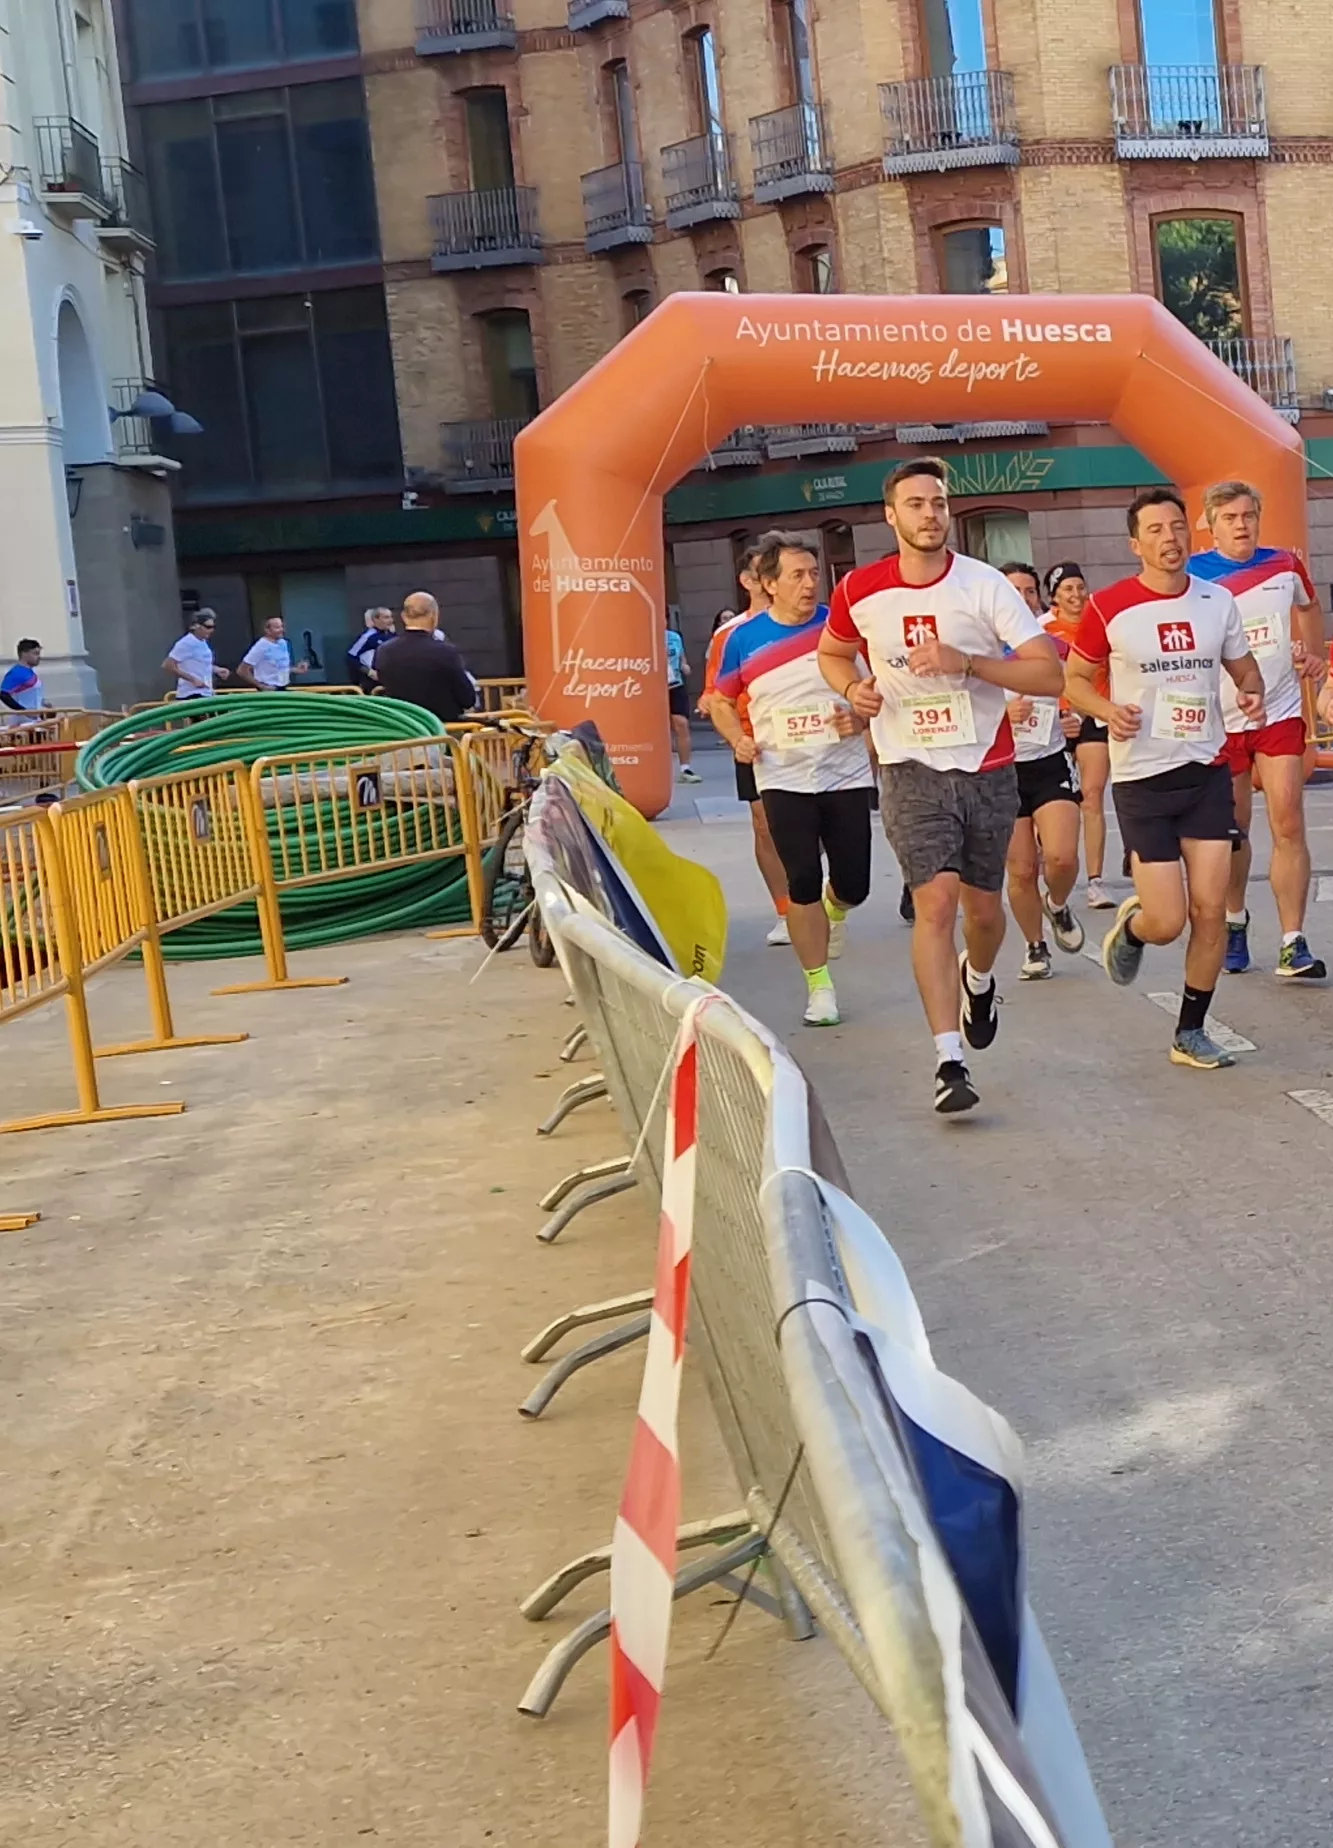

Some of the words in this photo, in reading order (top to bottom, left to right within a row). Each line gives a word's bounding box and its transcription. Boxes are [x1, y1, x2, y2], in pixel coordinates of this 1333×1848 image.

[736, 316, 948, 347] Ayuntamiento
[957, 318, 992, 342] de
[1001, 318, 1112, 343] Huesca
[812, 349, 934, 384] Hacemos
[938, 348, 1041, 393] deporte
[532, 553, 653, 577] Ayuntamiento
[532, 577, 551, 593] de
[556, 575, 632, 593] Huesca
[562, 648, 652, 675] Hacemos
[1140, 656, 1214, 674] salesianos
[562, 674, 643, 709] deporte
[787, 714, 822, 730] 575
[912, 707, 953, 726] 391
[1171, 707, 1206, 724] 390
[912, 725, 959, 735] LORENZO
